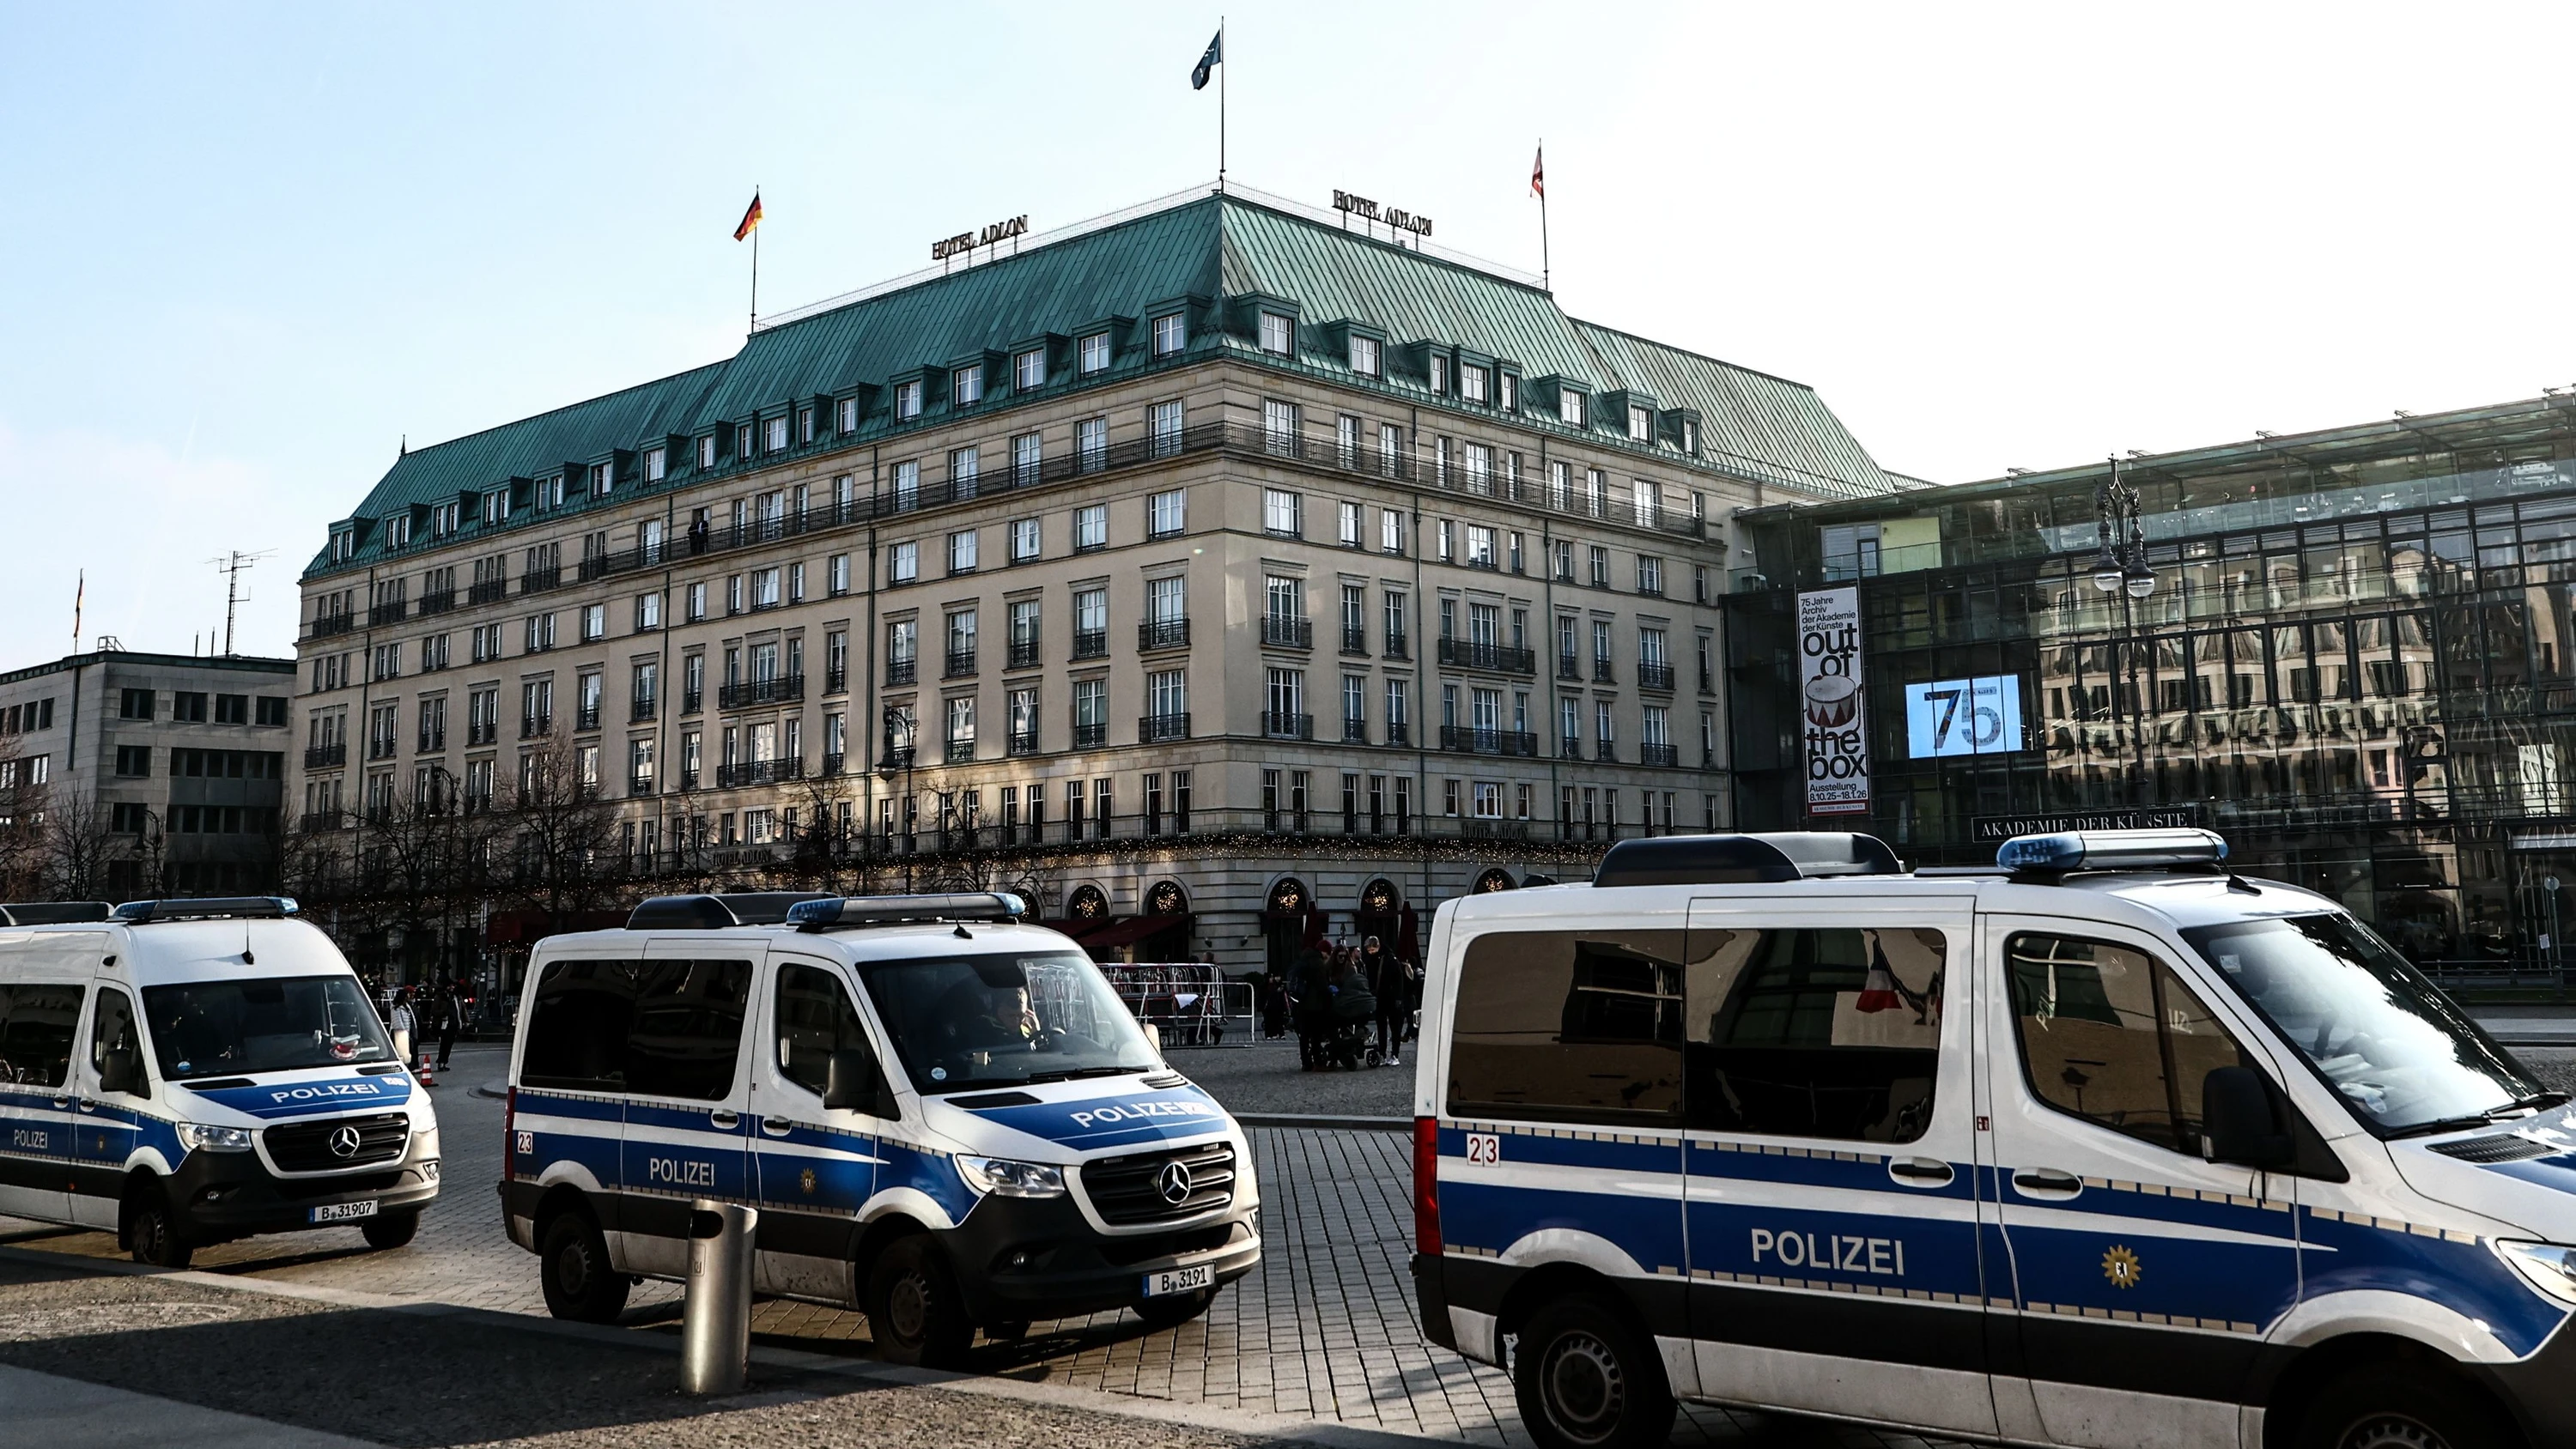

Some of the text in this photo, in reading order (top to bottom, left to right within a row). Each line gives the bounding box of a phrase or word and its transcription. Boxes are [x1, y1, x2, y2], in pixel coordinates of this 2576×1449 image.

[1332, 189, 1432, 236] HOTEL ADLON
[932, 214, 1029, 260] HOTEL ADLON
[1801, 597, 1833, 606] 75 Jahre
[1801, 605, 1827, 615] Archiv
[1801, 610, 1856, 624] der Akademie
[1816, 621, 1844, 631] Künste
[1803, 622, 1858, 657] out
[1820, 645, 1854, 677] of
[1924, 686, 2002, 749] 75
[1807, 727, 1861, 755] the
[1807, 749, 1867, 781] box
[1810, 782, 1856, 792] Ausstellung
[1463, 825, 1528, 840] HOTEL ADLON
[1982, 819, 2069, 836] AKADEMIE
[2075, 816, 2110, 830] DER
[712, 848, 772, 866] HOTEL ADLON
[270, 1084, 380, 1103] POLIZEI
[1070, 1101, 1187, 1128] POLIZEI
[14, 1129, 48, 1149] POLIZEI
[519, 1133, 532, 1152] 23
[1469, 1137, 1497, 1163] 23
[650, 1157, 714, 1186] POLIZEI
[322, 1202, 372, 1219] B 31907
[1751, 1228, 1905, 1276] POLIZEI
[1162, 1267, 1206, 1291] B 3191
